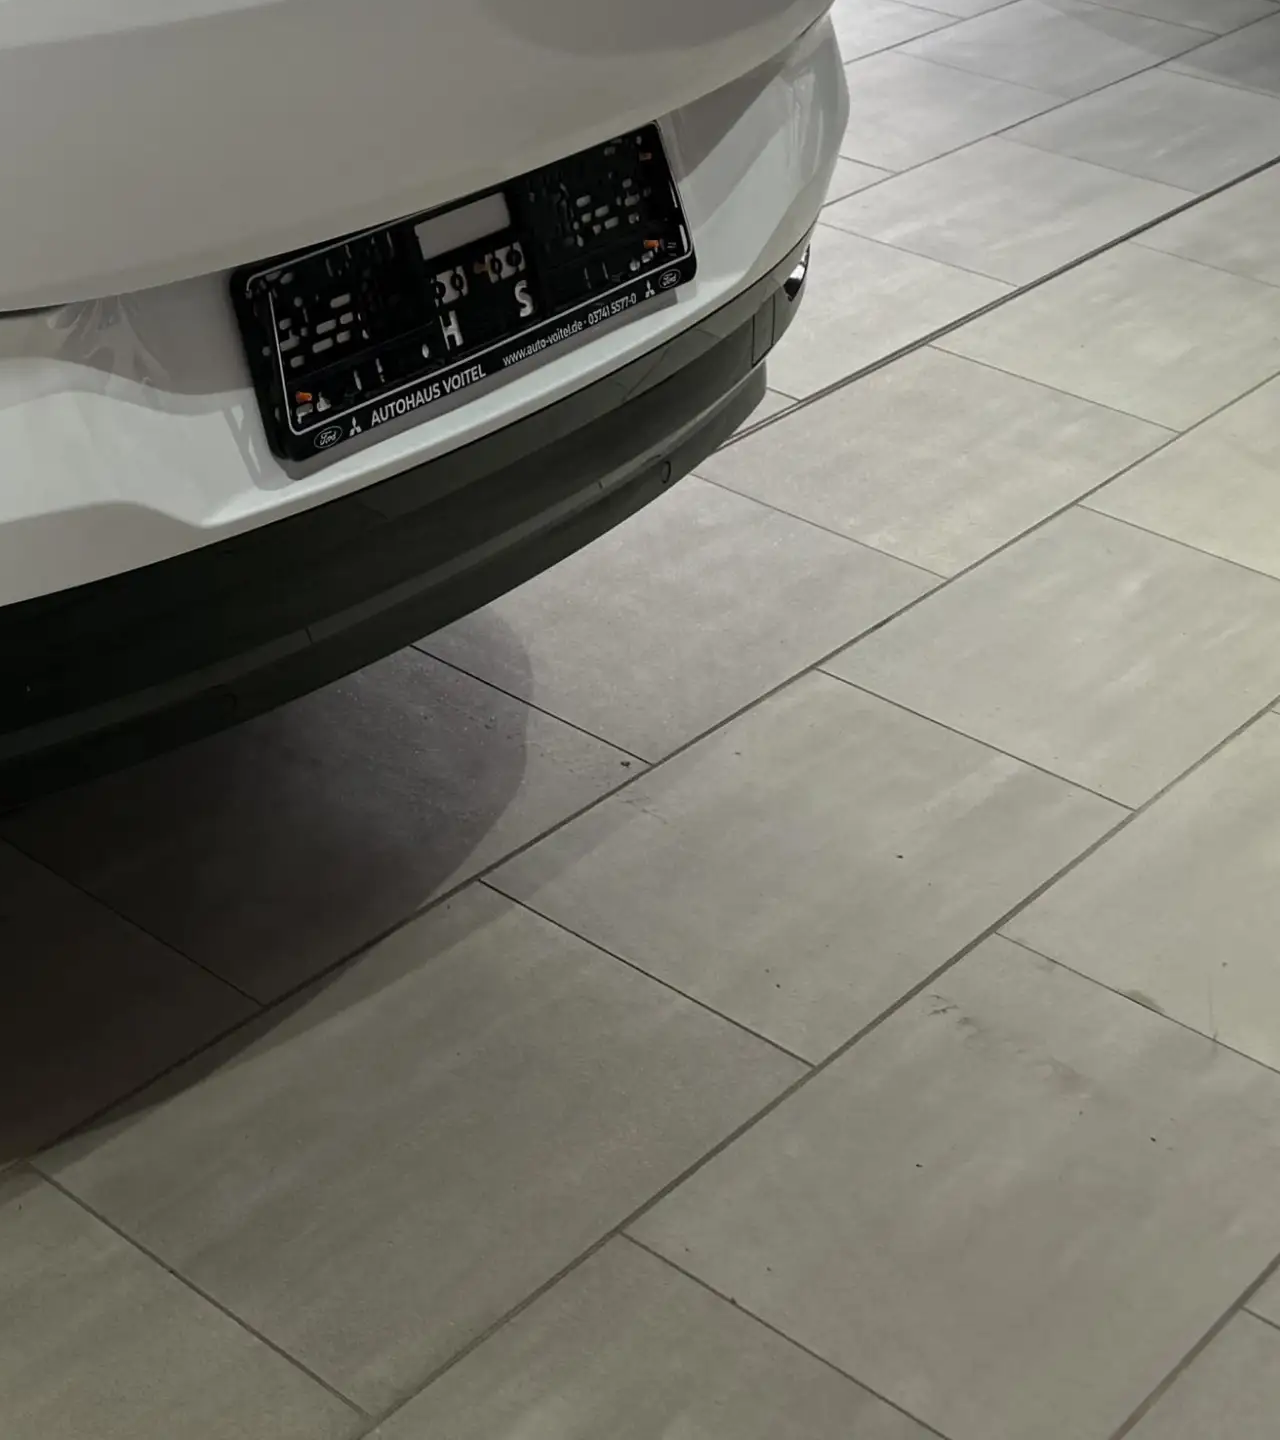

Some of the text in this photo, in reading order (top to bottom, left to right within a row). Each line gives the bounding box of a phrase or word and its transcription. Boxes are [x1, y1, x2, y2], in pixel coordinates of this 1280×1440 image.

[501, 320, 584, 367] www.auto-voitel.de
[587, 307, 611, 327] 03741
[370, 363, 488, 428] AUTOHAUS VOITEL
